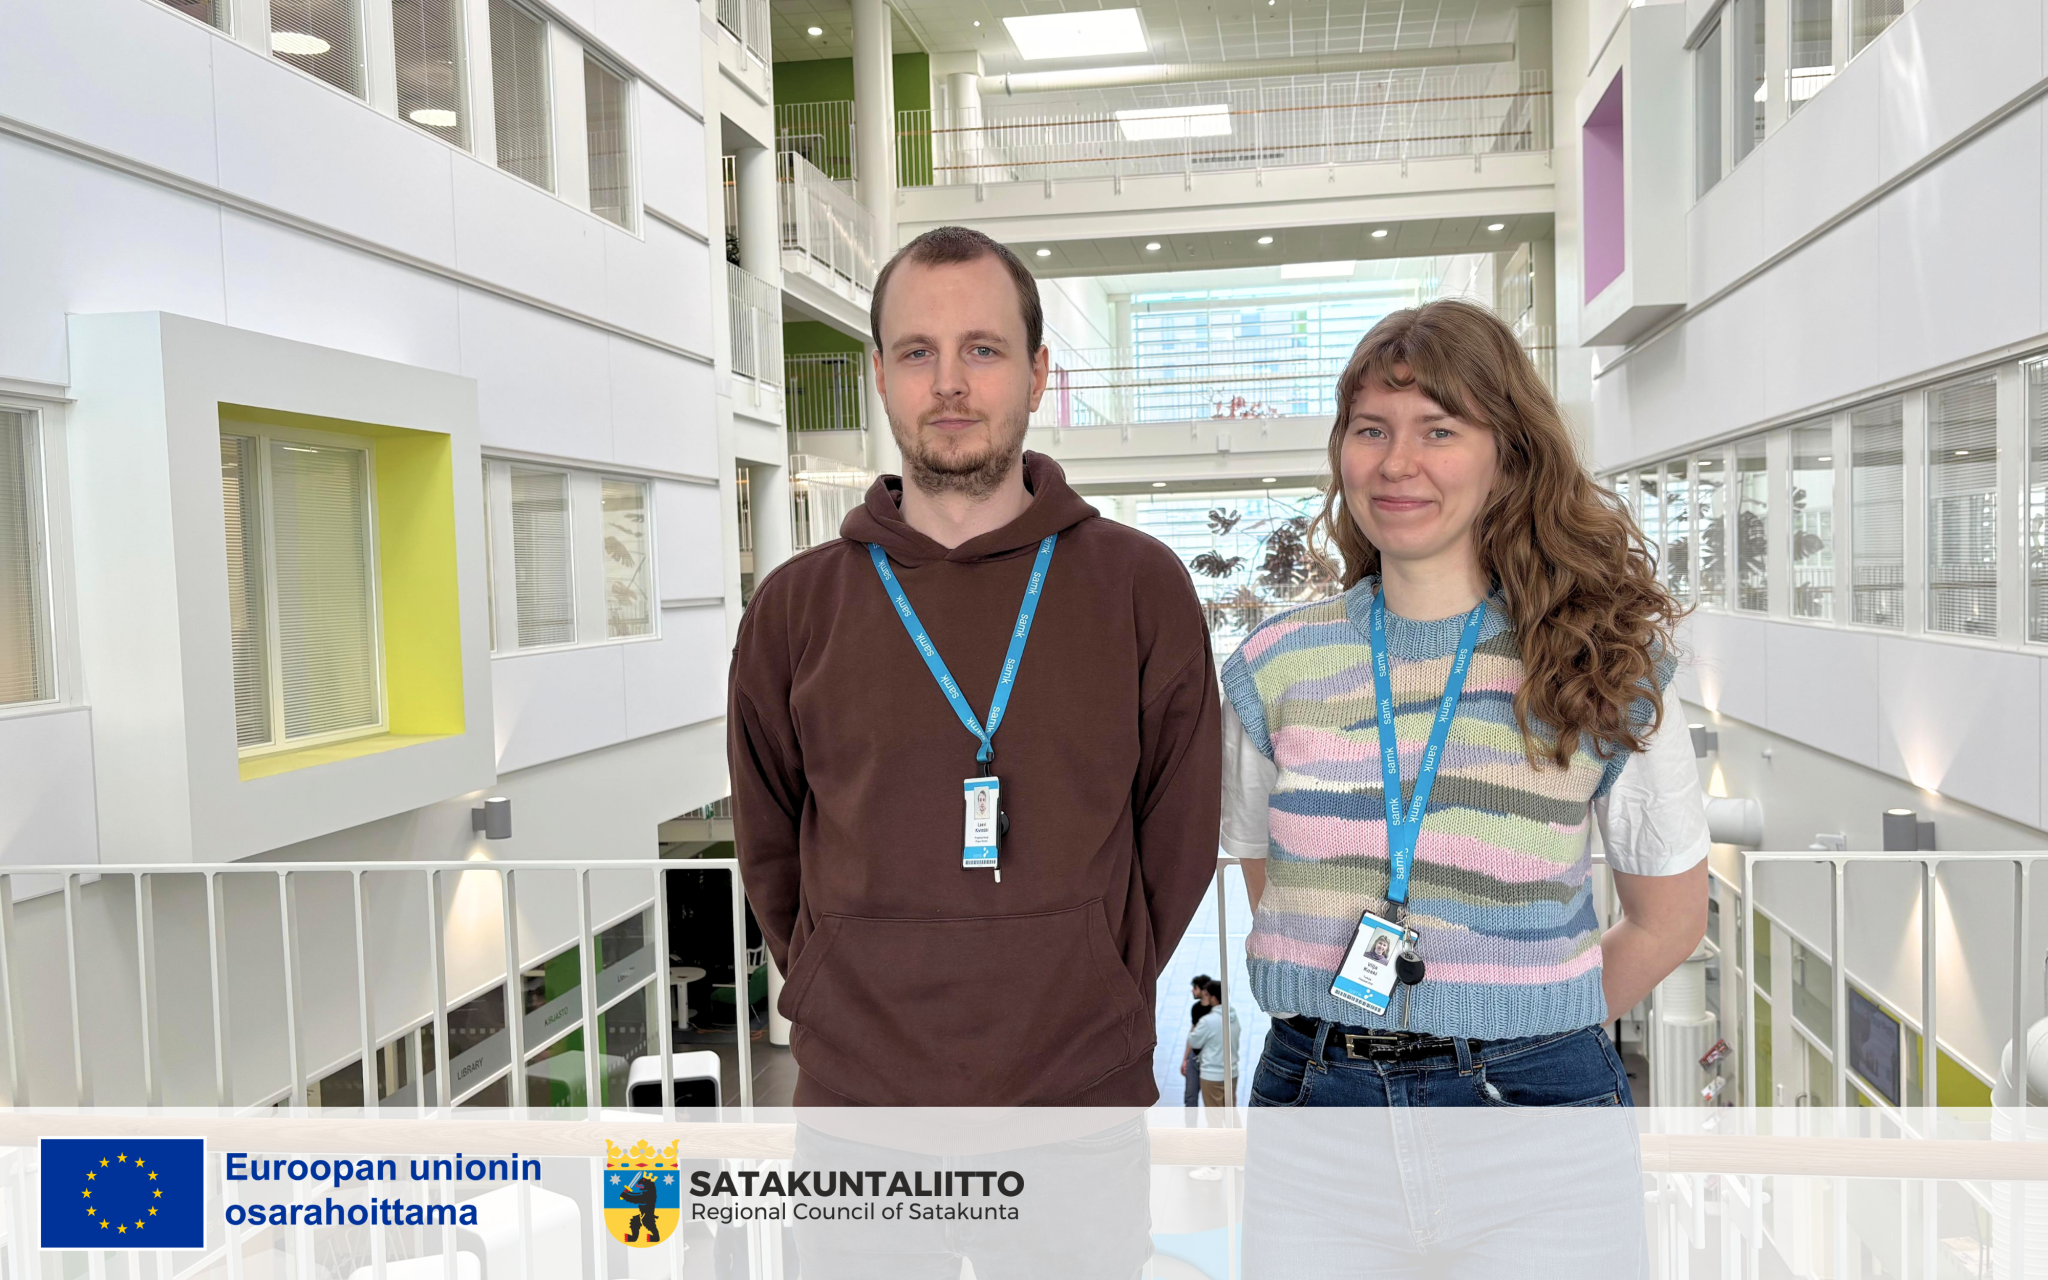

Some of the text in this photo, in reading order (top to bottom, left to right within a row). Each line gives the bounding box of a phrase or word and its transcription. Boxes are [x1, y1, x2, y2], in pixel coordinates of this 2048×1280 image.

[878, 558, 891, 581] samk
[1029, 571, 1042, 596] samk
[895, 594, 912, 618] samk
[1374, 607, 1382, 631] samk
[1468, 603, 1481, 627] amk
[1014, 613, 1029, 639] samk
[916, 632, 935, 657] samk
[1000, 658, 1016, 685] samk
[1375, 650, 1387, 677] samk
[1454, 648, 1468, 675] samk
[940, 674, 960, 700] samk
[986, 706, 1001, 733] samk
[1381, 698, 1392, 725] samk
[1439, 696, 1453, 723] samk
[1385, 746, 1397, 775] samk
[1424, 744, 1438, 773] samk
[1389, 798, 1400, 825] samk
[1409, 796, 1423, 823] samk
[1394, 851, 1404, 880] samk
[544, 1005, 568, 1027] KIRJASTO
[457, 1056, 483, 1081] LIBRARY
